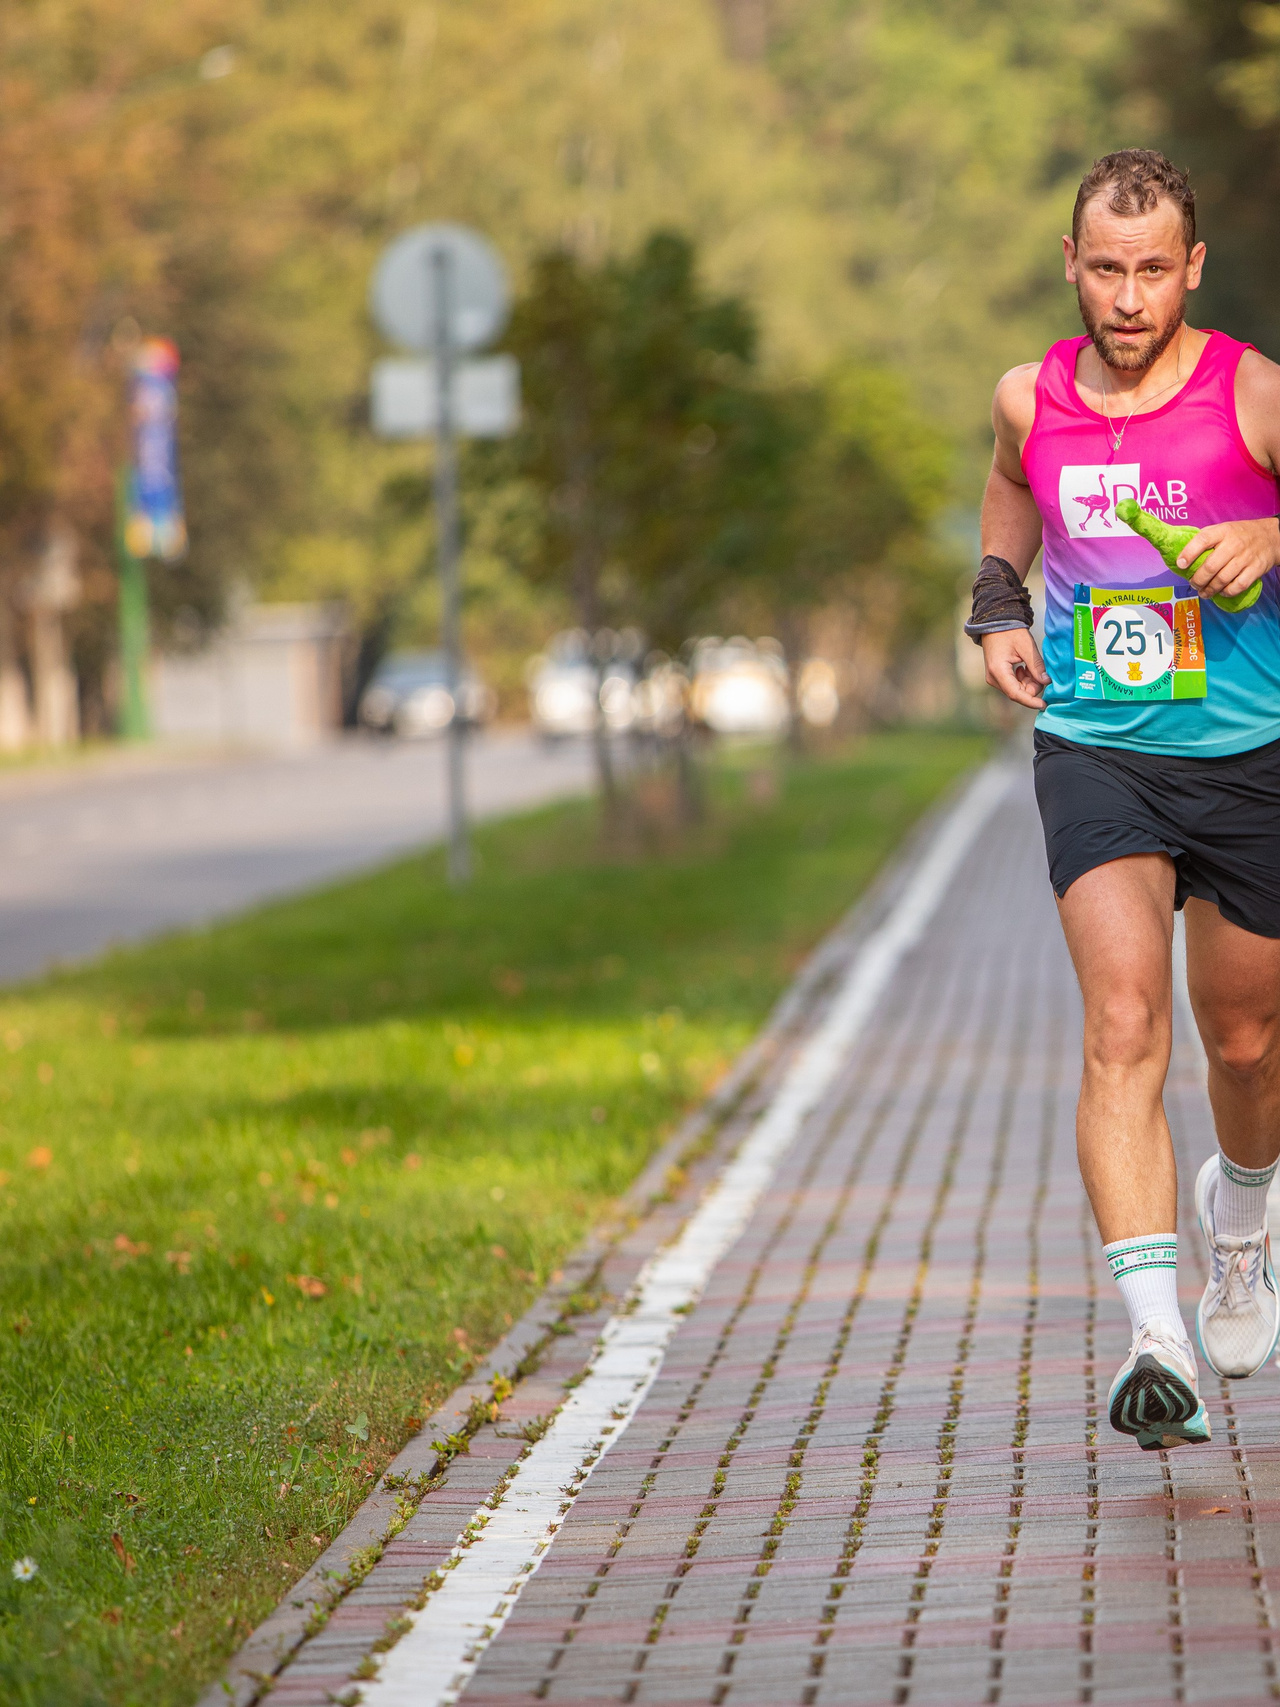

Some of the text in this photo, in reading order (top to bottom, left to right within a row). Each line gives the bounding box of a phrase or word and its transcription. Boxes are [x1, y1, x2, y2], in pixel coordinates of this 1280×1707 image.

[1113, 480, 1188, 507] DAB
[1115, 507, 1188, 521] NING
[1093, 594, 1170, 620] DREAM TRAIL LYSKOVO
[1103, 619, 1163, 656] 25 1
[1186, 610, 1199, 661] ЭСТАФЕТА
[1104, 676, 1134, 696] KANNAS
[1147, 682, 1162, 694] ЛЕС
